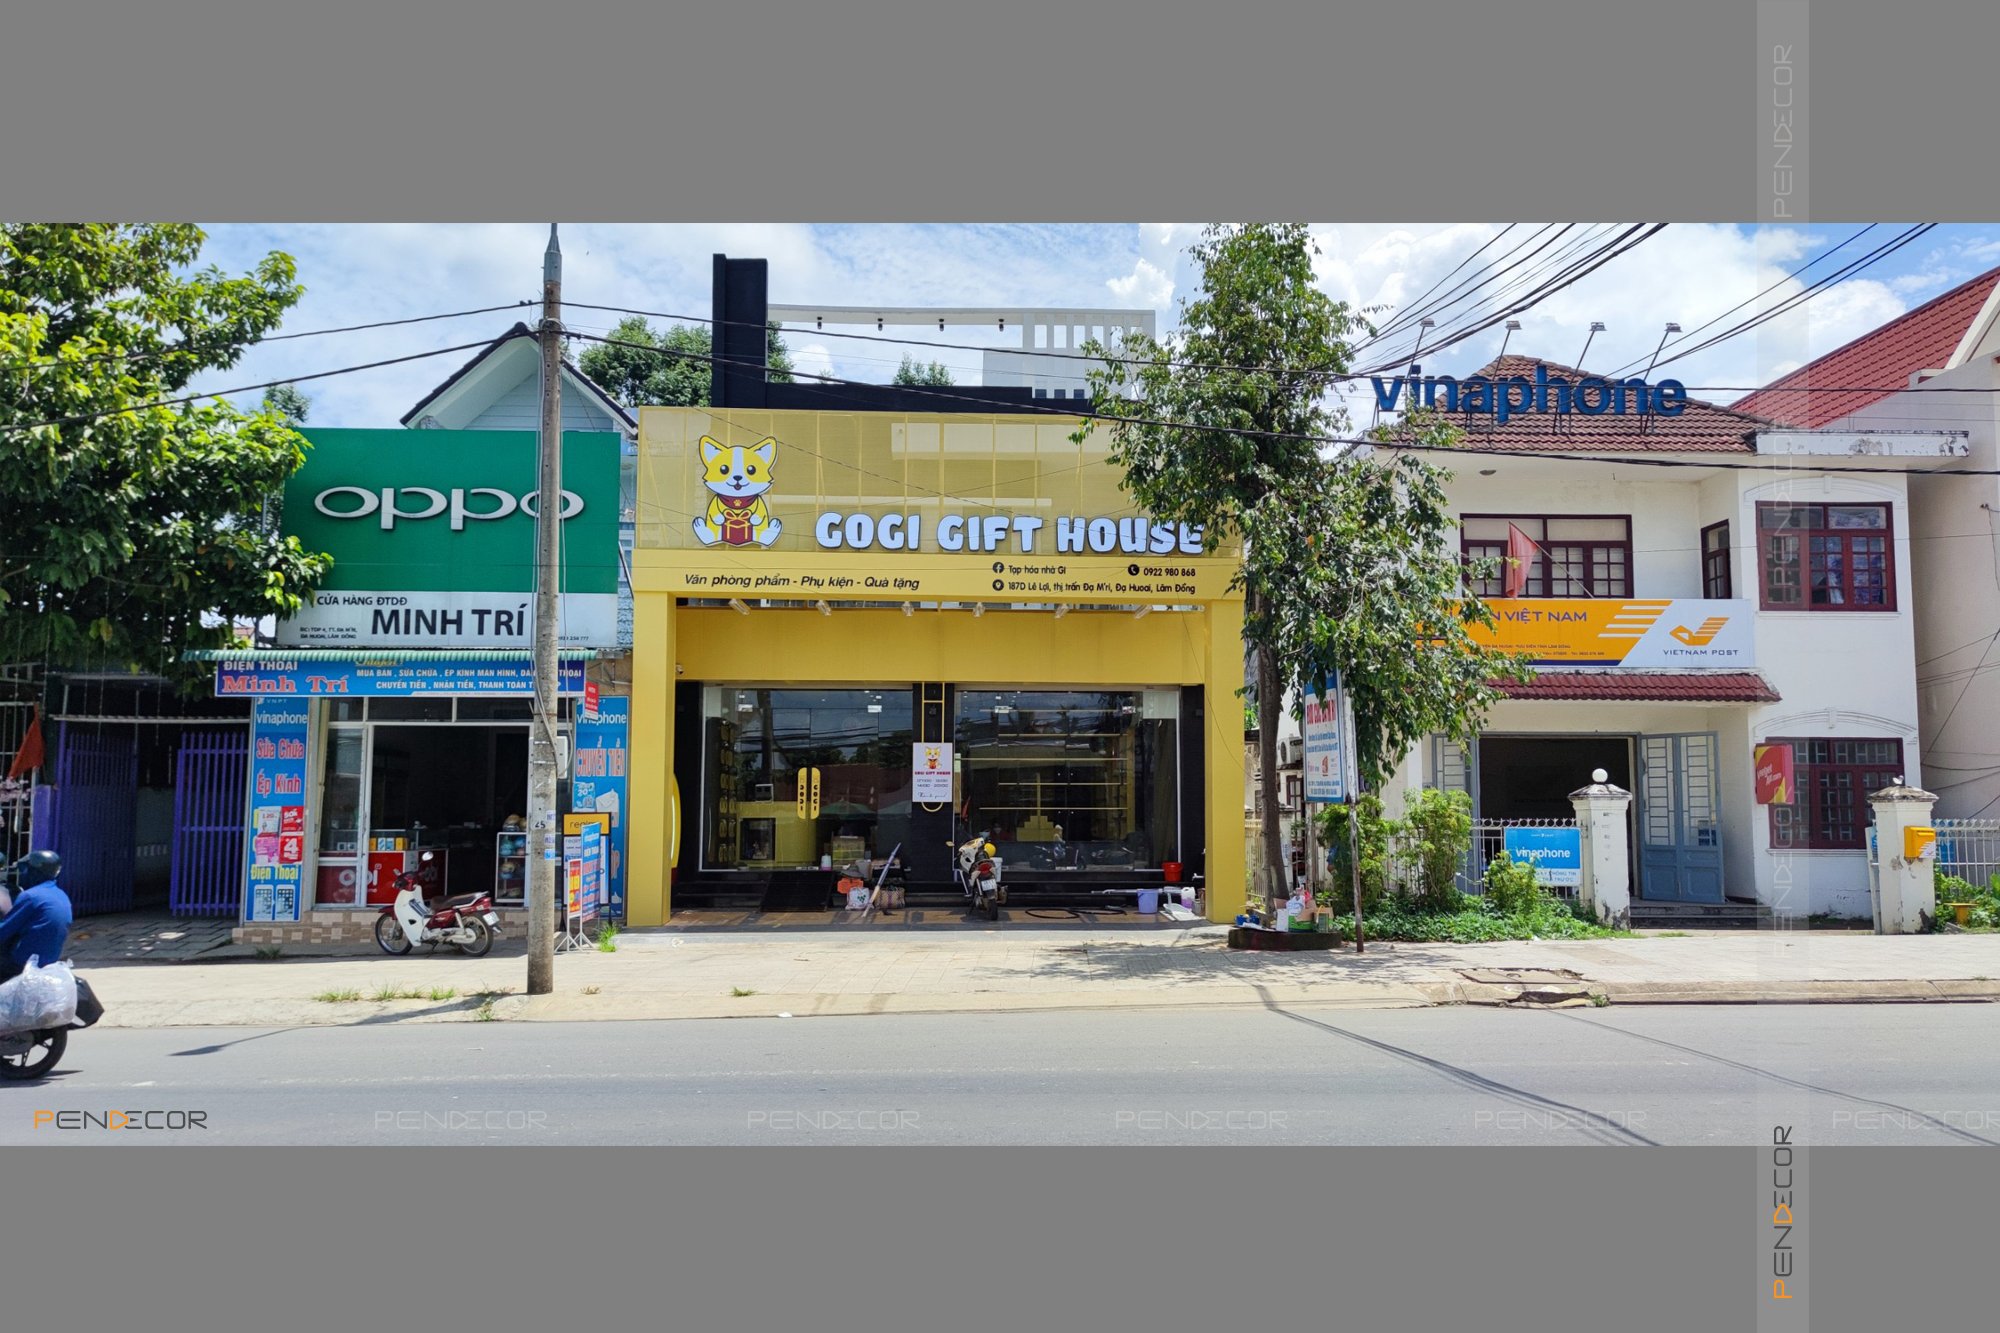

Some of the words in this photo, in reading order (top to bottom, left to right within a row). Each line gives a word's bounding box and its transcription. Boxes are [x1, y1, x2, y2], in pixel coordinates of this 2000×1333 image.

[1370, 364, 1688, 427] vinaphone
[815, 511, 921, 551] GOGI
[936, 514, 1043, 553] GIFT
[1056, 516, 1205, 555] HOUSE
[1024, 565, 1039, 574] hóa
[1041, 565, 1055, 574] nhà
[1143, 568, 1162, 577] 0922
[1164, 568, 1179, 577] 980
[1181, 568, 1196, 577] 868
[684, 573, 707, 585] Văn
[711, 574, 751, 587] phòng
[754, 572, 790, 587] phẩm
[801, 576, 824, 587] Phụ
[828, 576, 854, 587] kiện
[864, 576, 889, 587] Quà
[893, 577, 920, 590] tặng
[1008, 581, 1026, 591] 187D
[1028, 582, 1037, 590] Lê
[1053, 582, 1064, 593] thị
[1065, 581, 1080, 591] trấn
[1083, 582, 1095, 593] Đạ
[1115, 583, 1127, 593] Đạ
[1129, 583, 1153, 593] Huoai,
[1156, 583, 1172, 592] Lâm
[1175, 582, 1196, 594] Đồng
[317, 593, 339, 605] CỬA
[342, 594, 373, 605] HÀNG
[376, 596, 408, 606] ĐTDĐ
[371, 608, 463, 635] MINH
[471, 603, 528, 636] TRÍ
[1504, 607, 1543, 624] VIỆT
[1547, 611, 1587, 622] NAM
[223, 660, 255, 673] ĐIỆN
[260, 660, 297, 673] THOẠI
[356, 669, 374, 677] MUA
[222, 675, 298, 693] Minh
[305, 674, 349, 693] Trí
[478, 681, 506, 689] THANH
[256, 710, 308, 727] vinaphone
[256, 736, 276, 759] Sửa
[278, 737, 305, 760] Chữa
[274, 773, 301, 794] Kính
